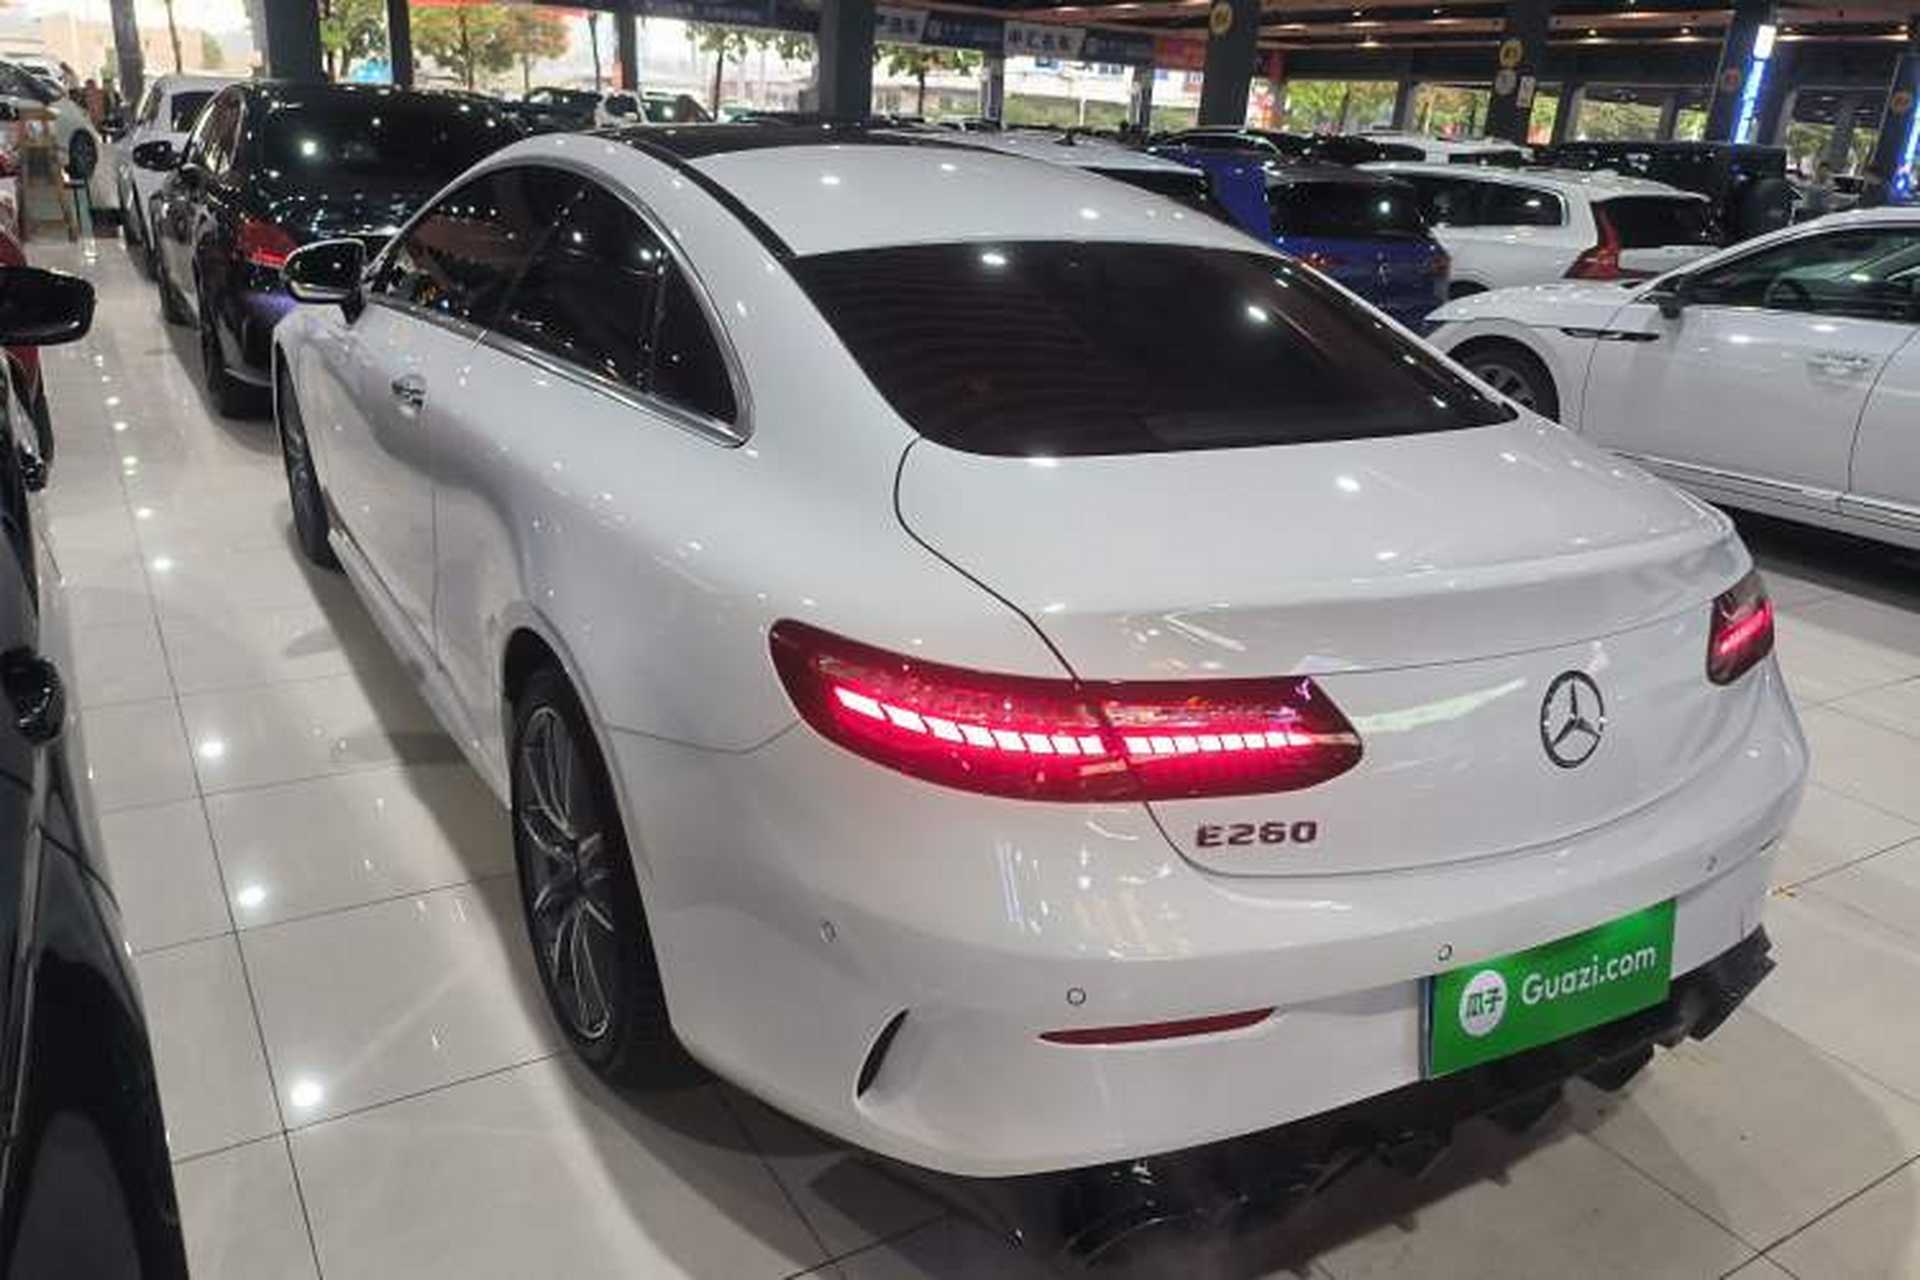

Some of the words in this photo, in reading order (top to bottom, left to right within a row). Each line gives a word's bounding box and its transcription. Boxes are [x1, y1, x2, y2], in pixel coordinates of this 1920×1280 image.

[1196, 821, 1318, 847] E260
[1466, 985, 1503, 1018] 瓜子
[1520, 945, 1657, 1005] Guazi.com
